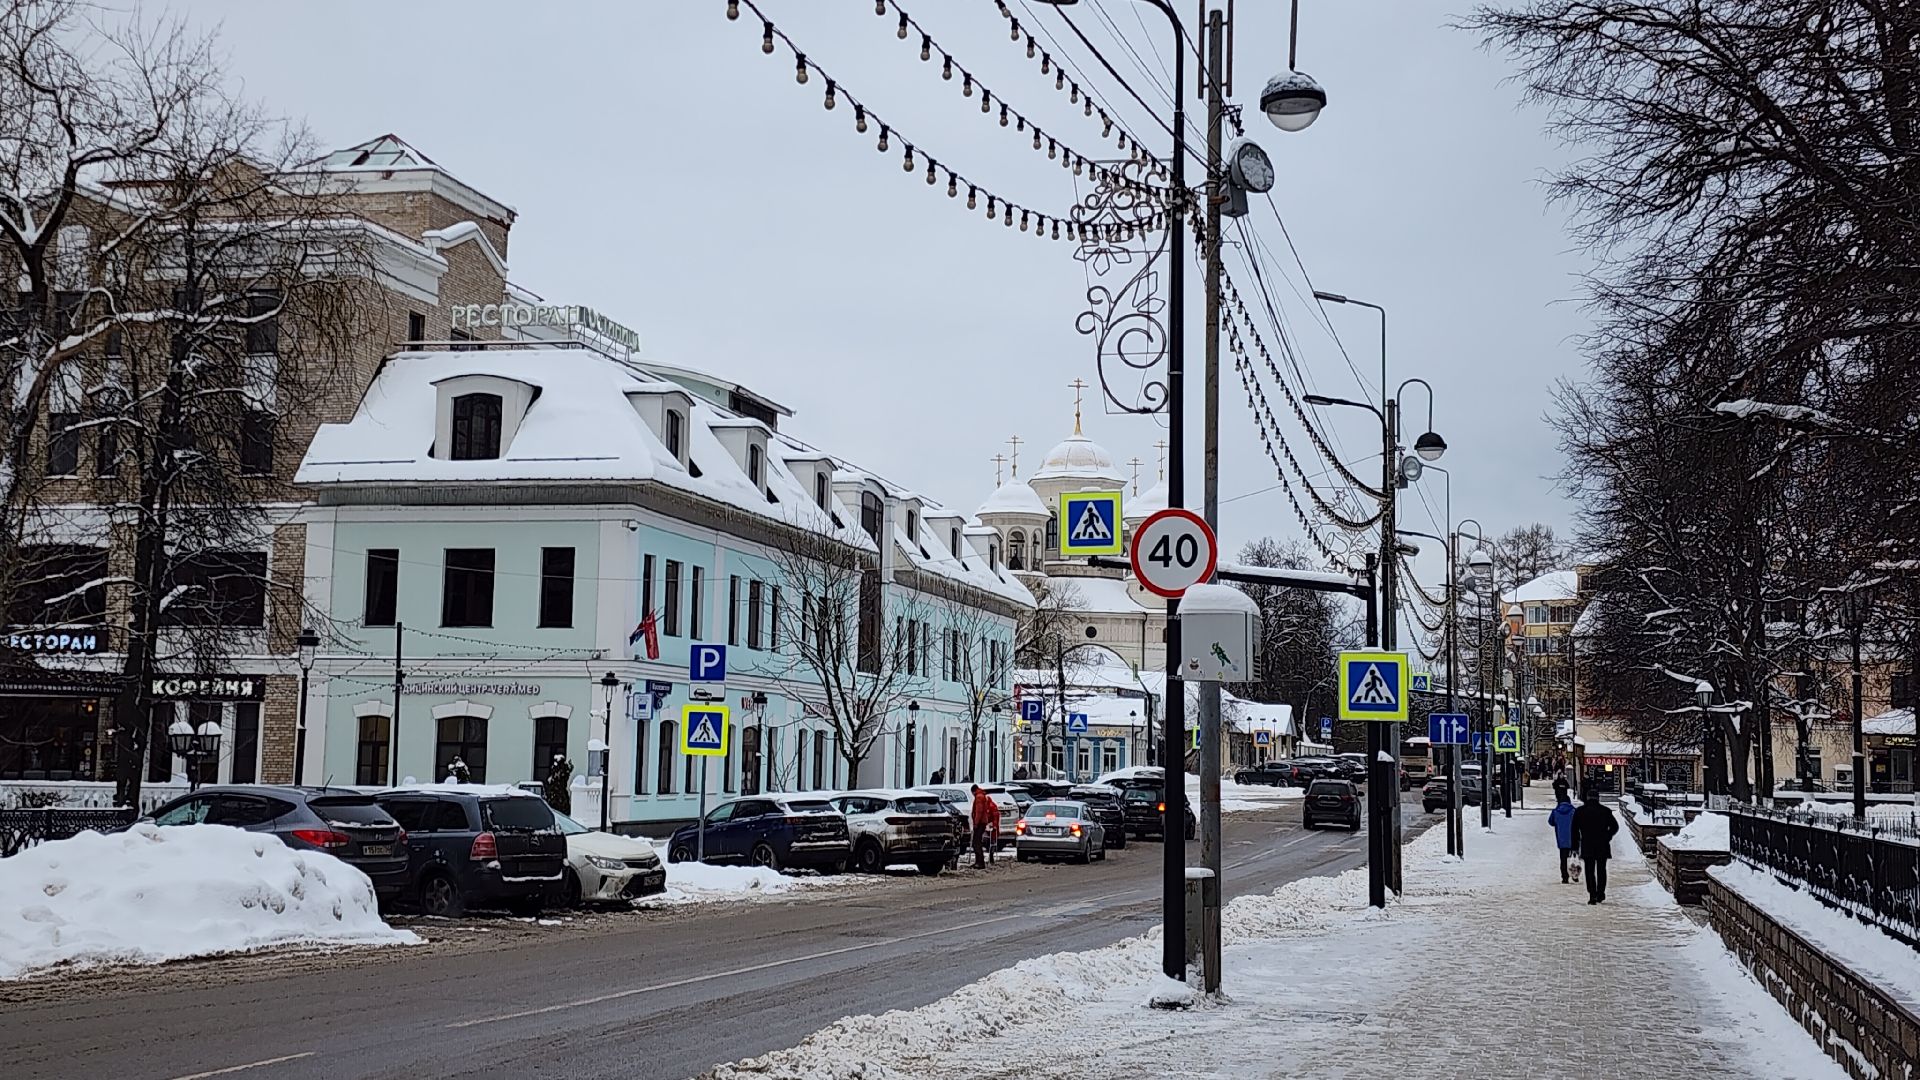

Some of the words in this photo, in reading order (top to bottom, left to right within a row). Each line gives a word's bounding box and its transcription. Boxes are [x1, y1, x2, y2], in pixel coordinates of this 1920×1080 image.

[451, 303, 580, 329] РЕСТОРАН
[1148, 533, 1198, 568] 40
[699, 647, 720, 678] P
[152, 678, 253, 696] КОФЕЙНЯ
[458, 684, 488, 695] ЦЕНТР
[1027, 702, 1039, 720] P
[1324, 719, 1330, 727] P
